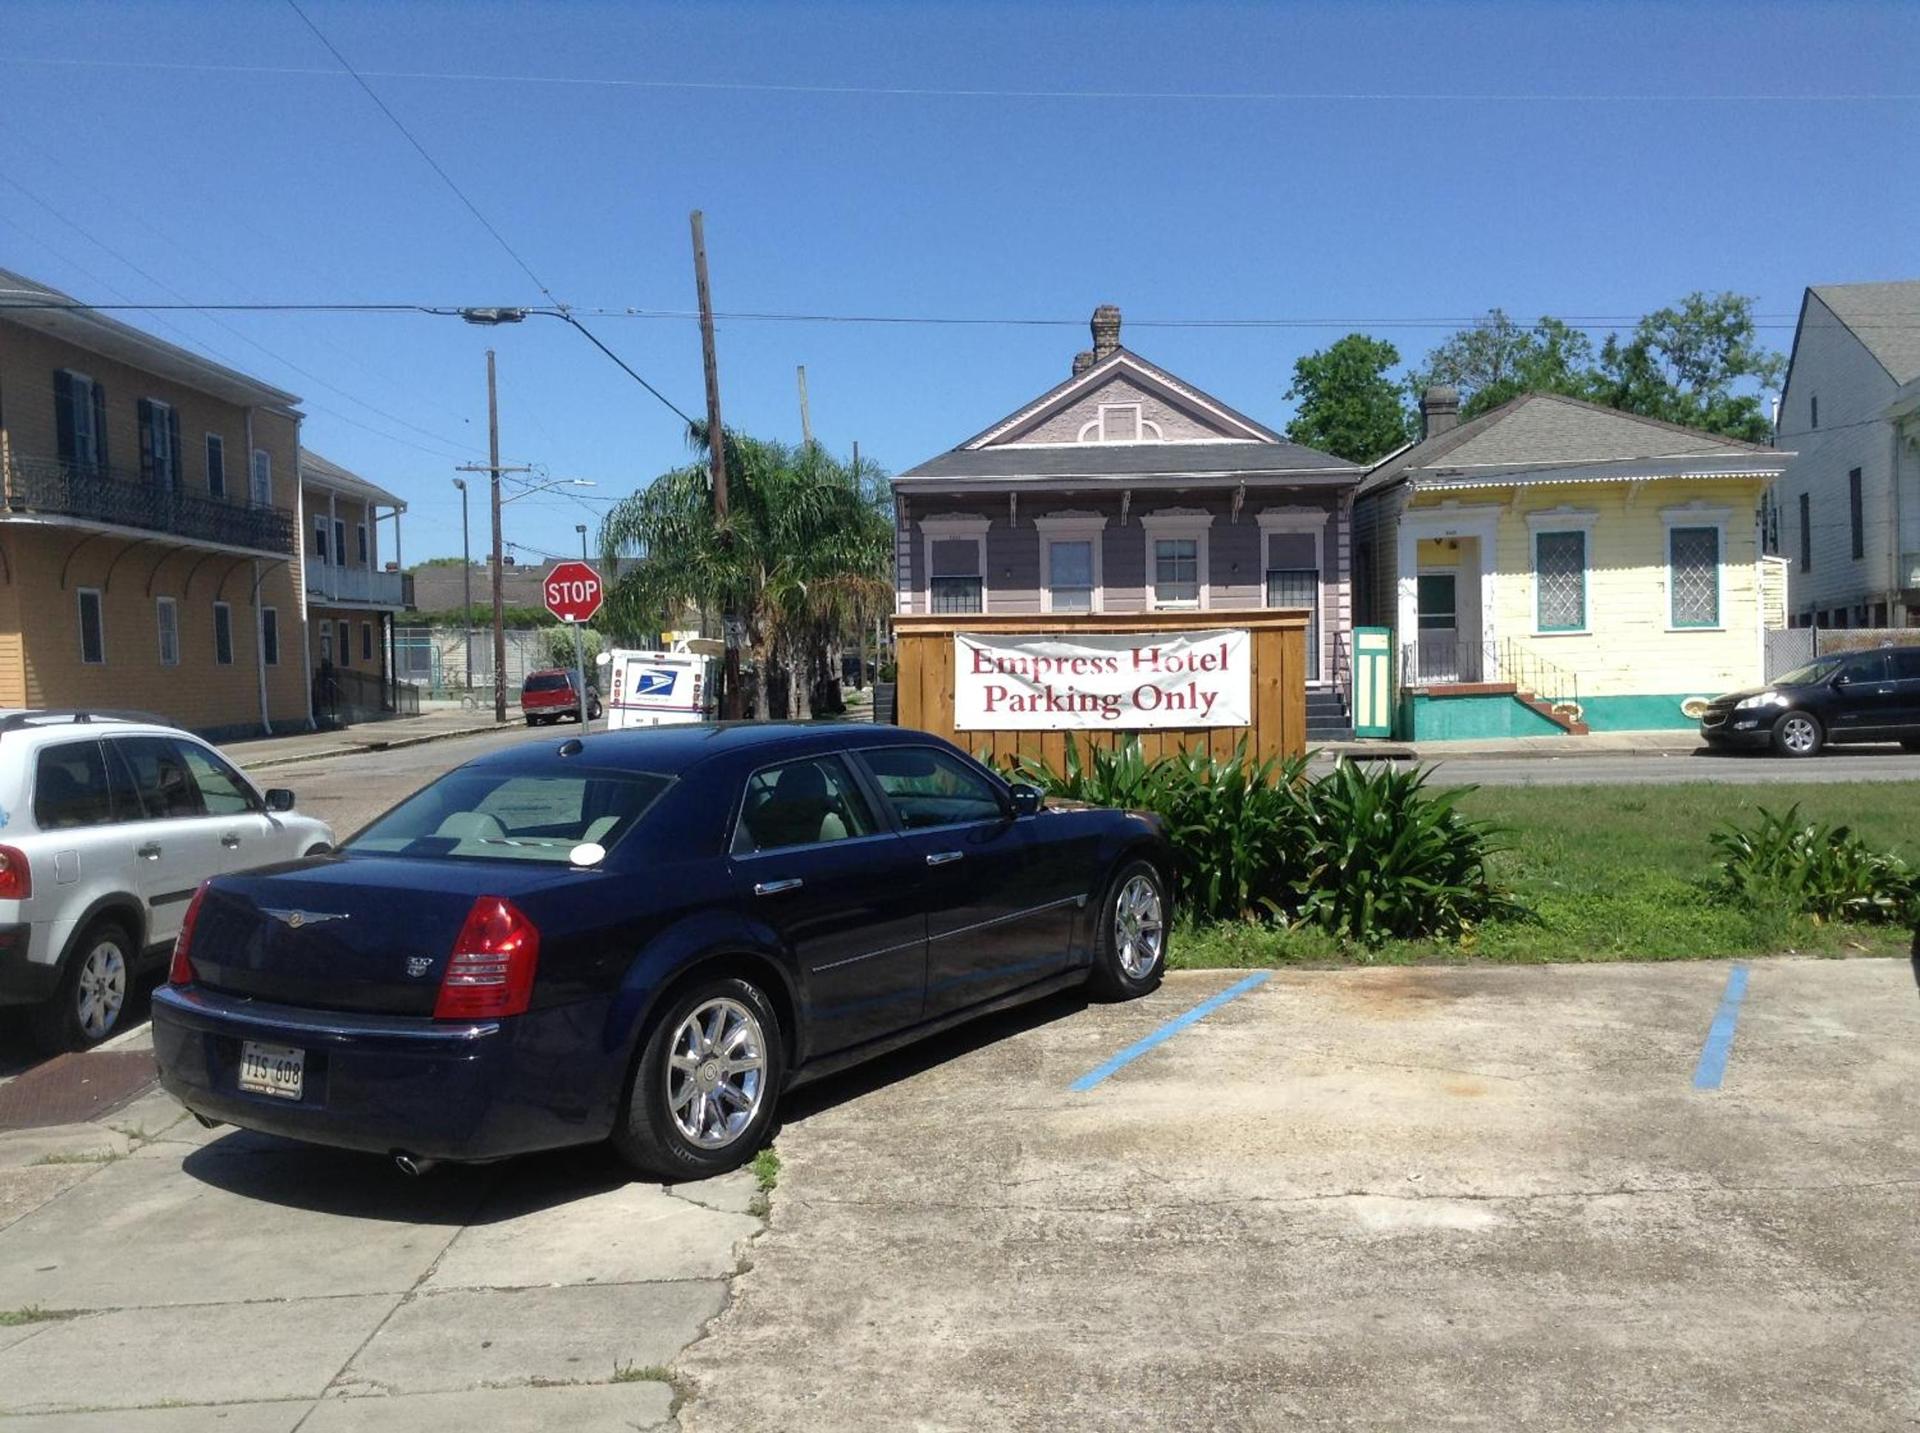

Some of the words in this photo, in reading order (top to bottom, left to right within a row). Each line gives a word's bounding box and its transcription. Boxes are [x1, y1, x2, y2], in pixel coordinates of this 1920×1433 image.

[548, 580, 597, 605] STOP
[971, 647, 1118, 684] Empress
[1130, 643, 1229, 673] Hotel
[984, 684, 1122, 720] Parking
[1132, 682, 1218, 717] Only
[247, 1054, 269, 1079] TIS
[276, 1059, 300, 1085] 608
